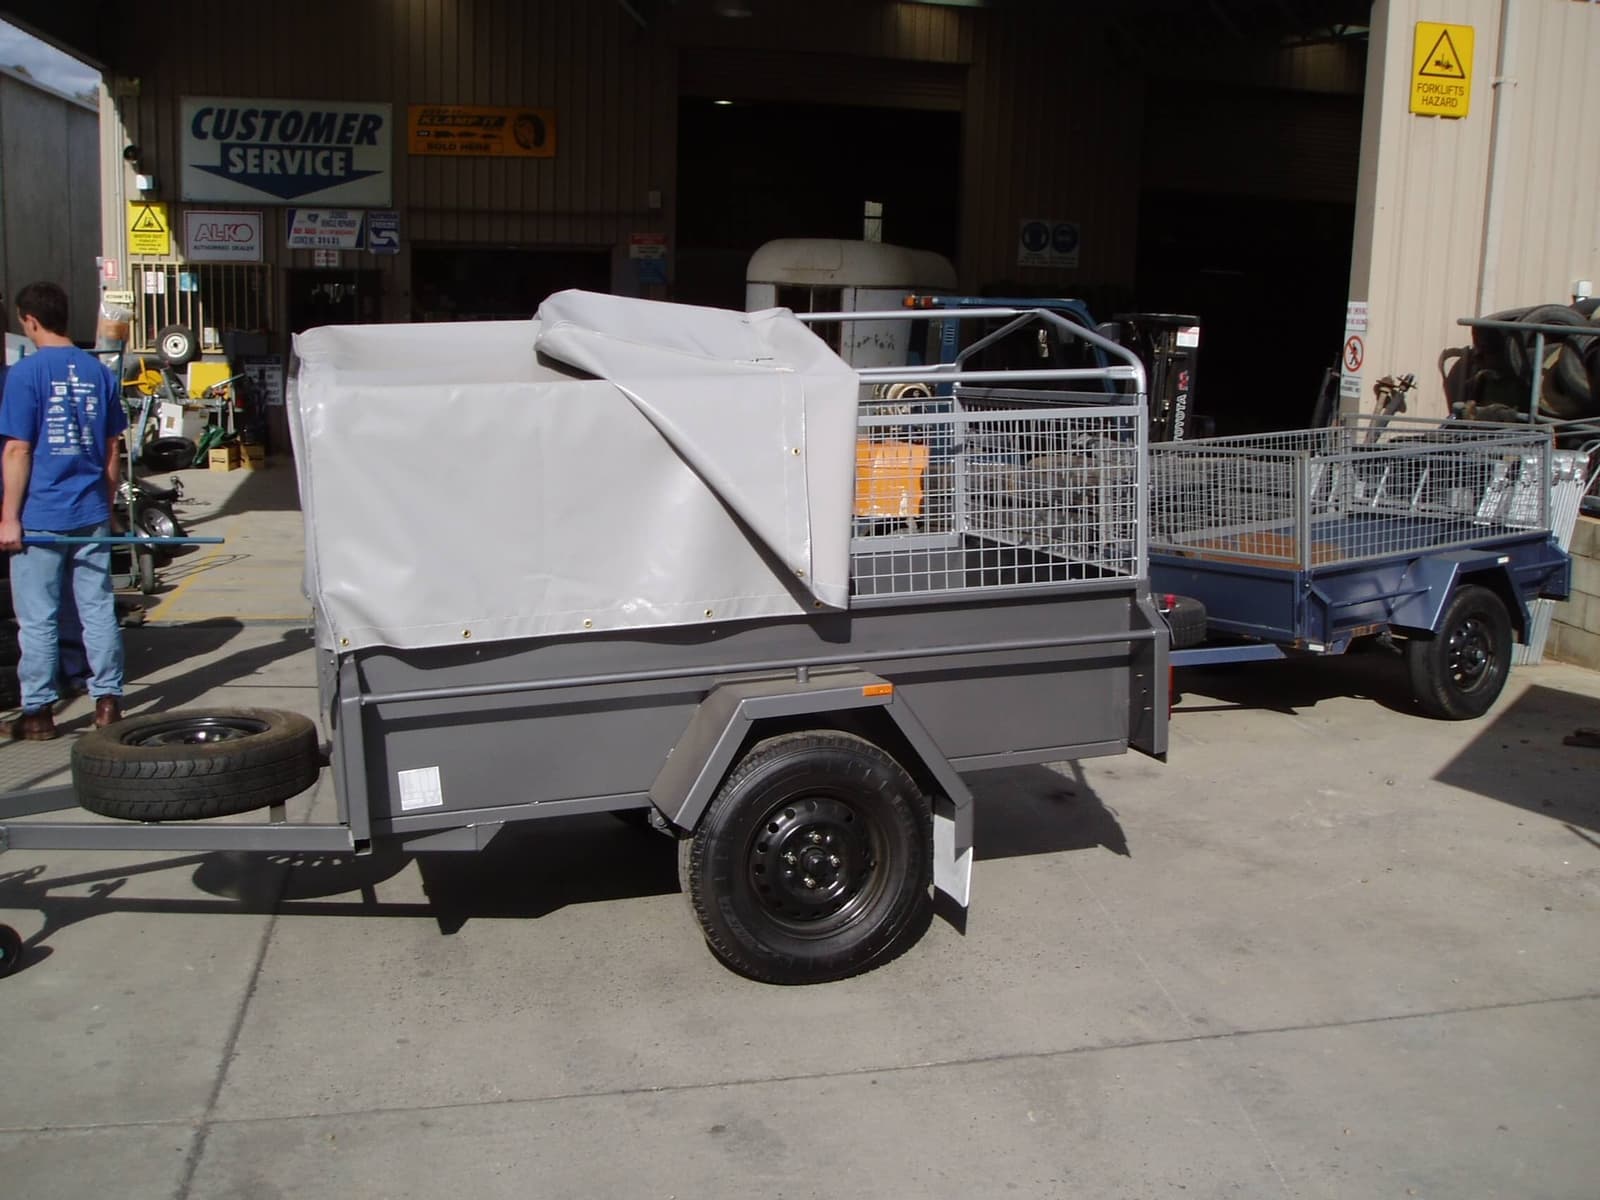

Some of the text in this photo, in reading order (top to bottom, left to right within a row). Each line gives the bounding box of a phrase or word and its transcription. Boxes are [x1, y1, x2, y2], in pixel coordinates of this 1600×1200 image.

[1416, 83, 1465, 96] FORKLIFTS
[1421, 96, 1458, 108] HAZARD
[191, 107, 384, 146] CUSTOMER
[228, 147, 346, 177] SERVICE
[194, 223, 255, 243] AL-KO
